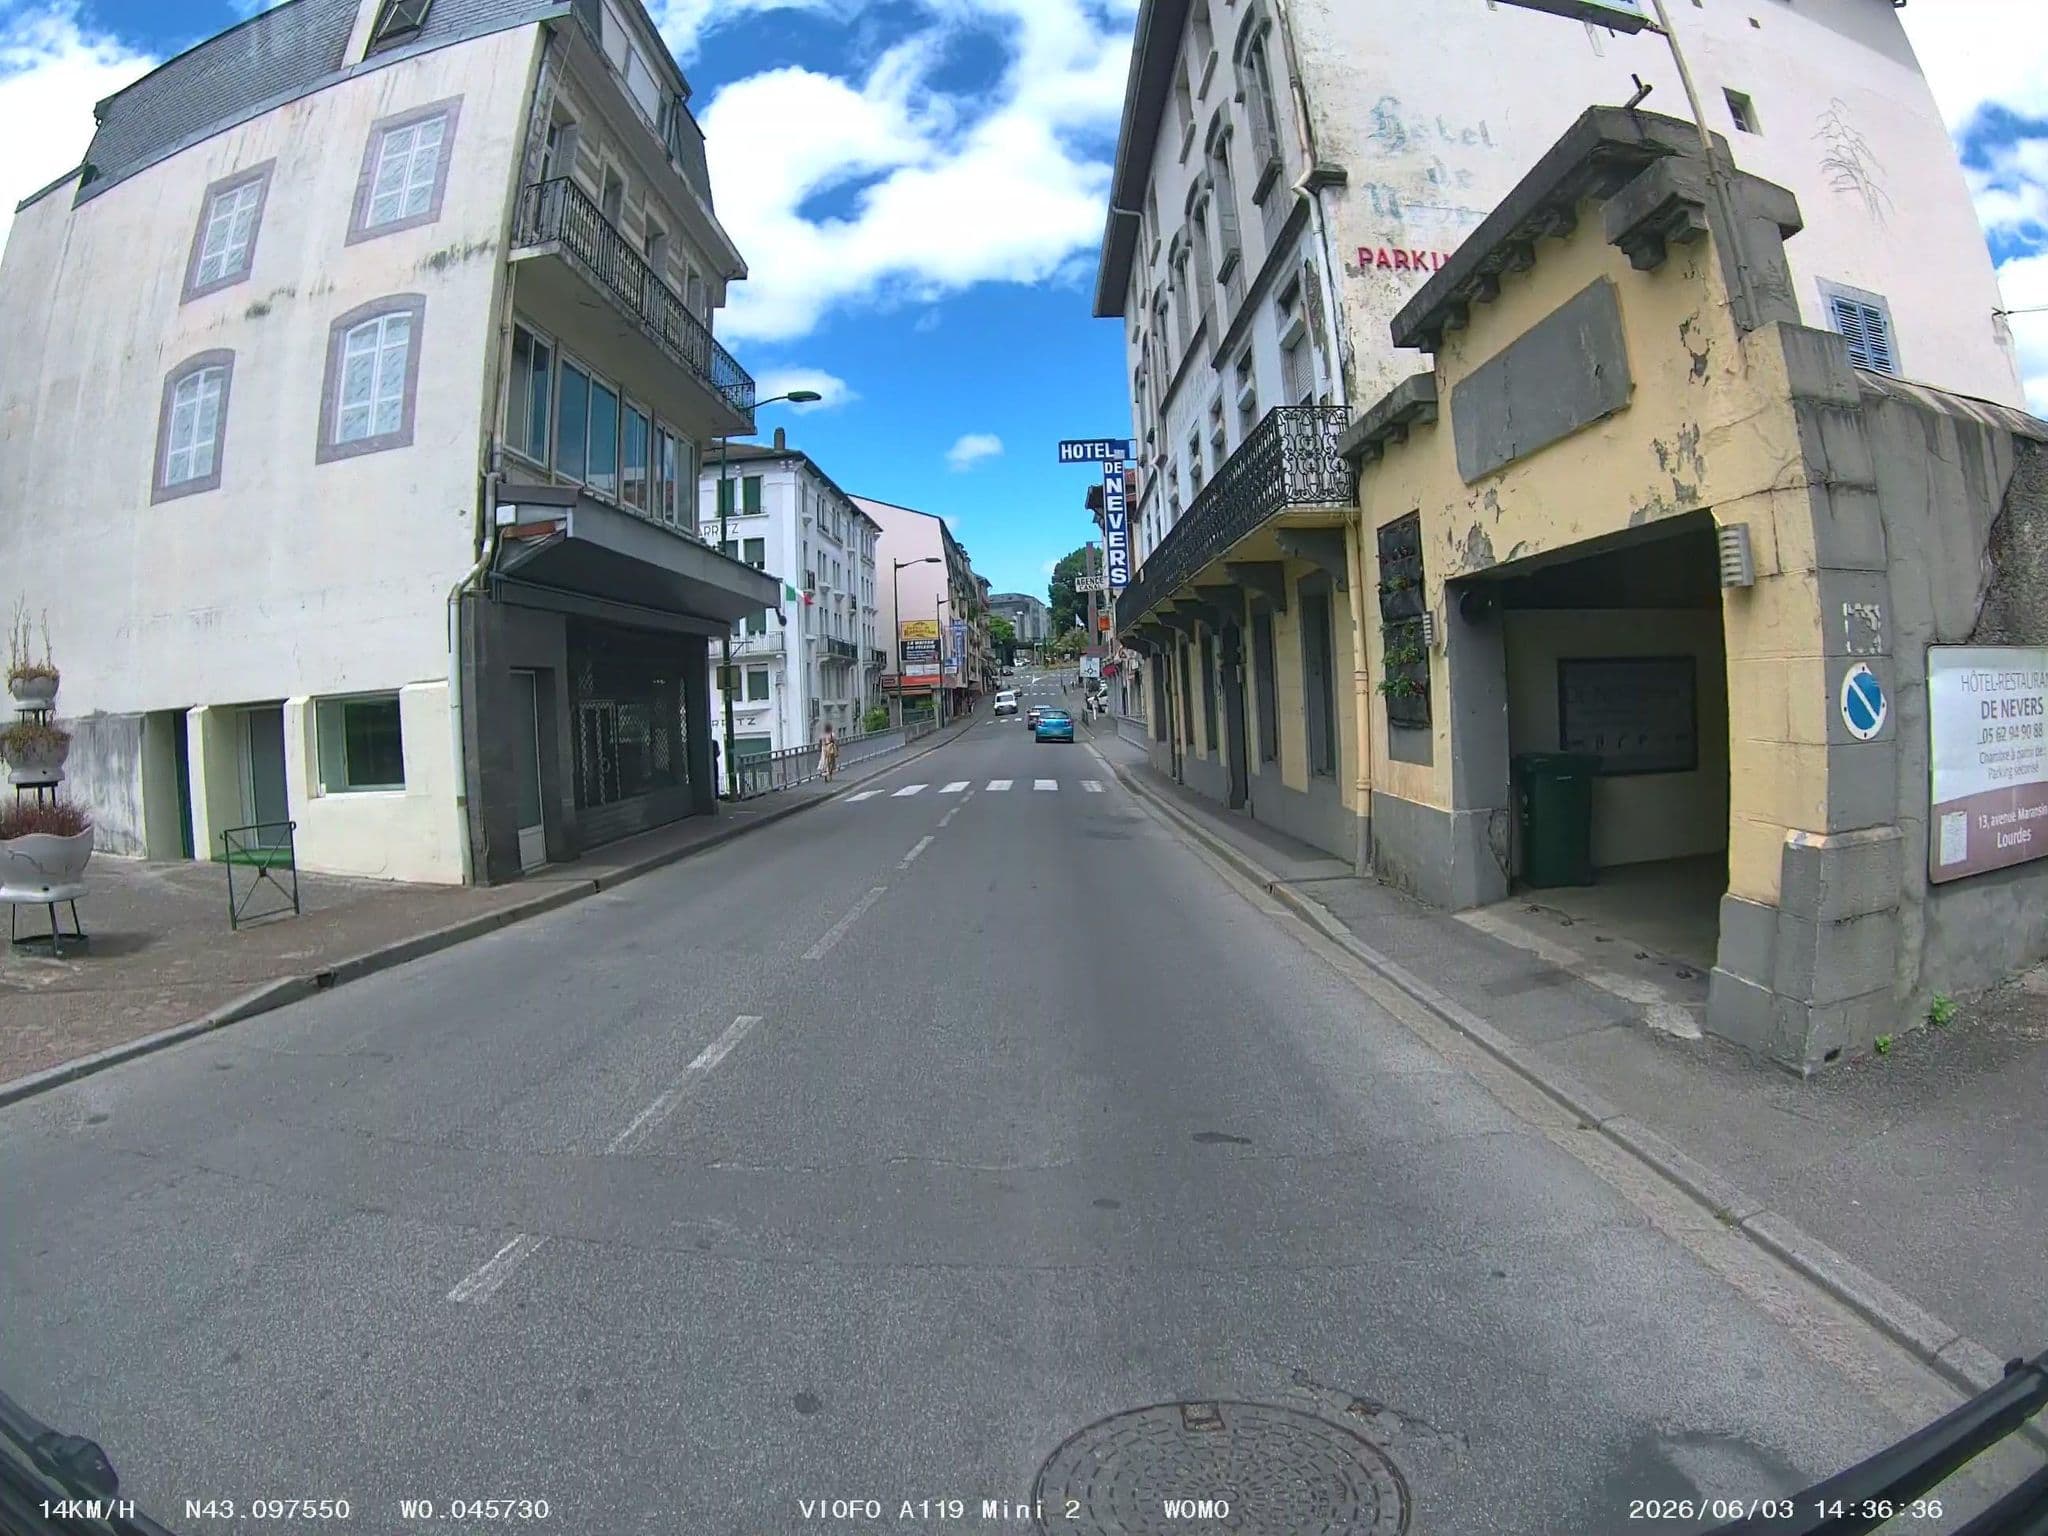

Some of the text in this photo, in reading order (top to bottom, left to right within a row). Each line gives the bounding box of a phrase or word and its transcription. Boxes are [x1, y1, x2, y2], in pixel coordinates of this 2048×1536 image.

[1061, 442, 1115, 460] HOTEL
[1104, 461, 1122, 474] DE
[1105, 477, 1128, 585] NEVERS
[1076, 576, 1105, 586] AGENCE
[1981, 696, 2043, 719] DE NEVERS
[1991, 811, 2017, 827] avenue
[1997, 827, 2032, 849] Lourdes
